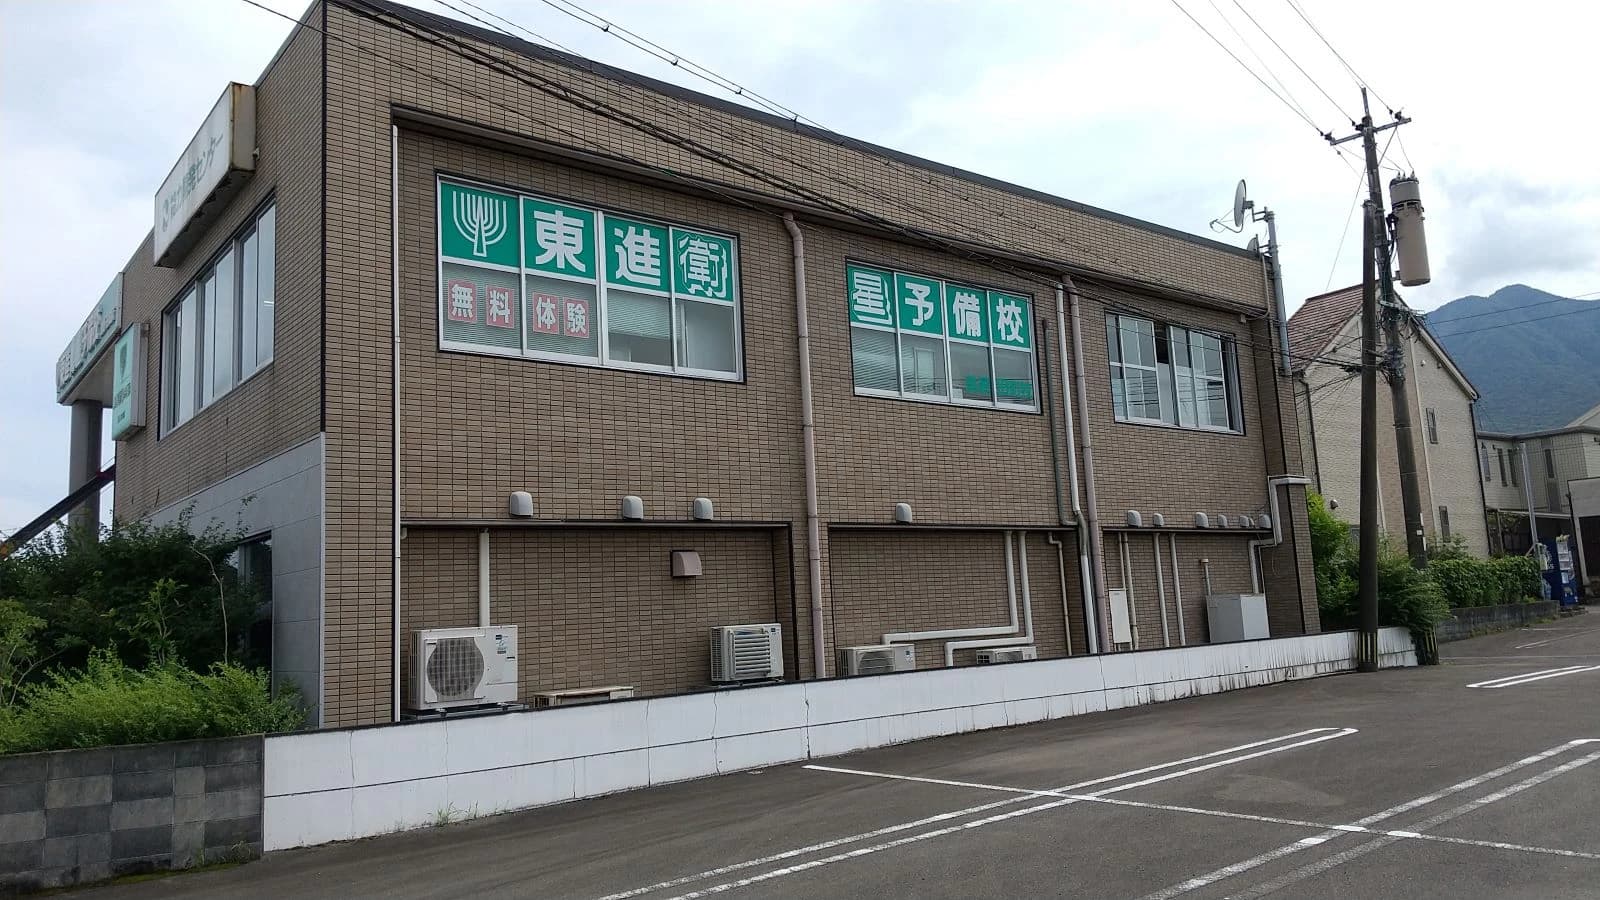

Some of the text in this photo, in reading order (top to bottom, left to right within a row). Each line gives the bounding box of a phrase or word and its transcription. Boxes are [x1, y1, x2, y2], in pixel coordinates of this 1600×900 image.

[450, 284, 588, 335] 無料体験
[852, 272, 1024, 344] 星予備校
